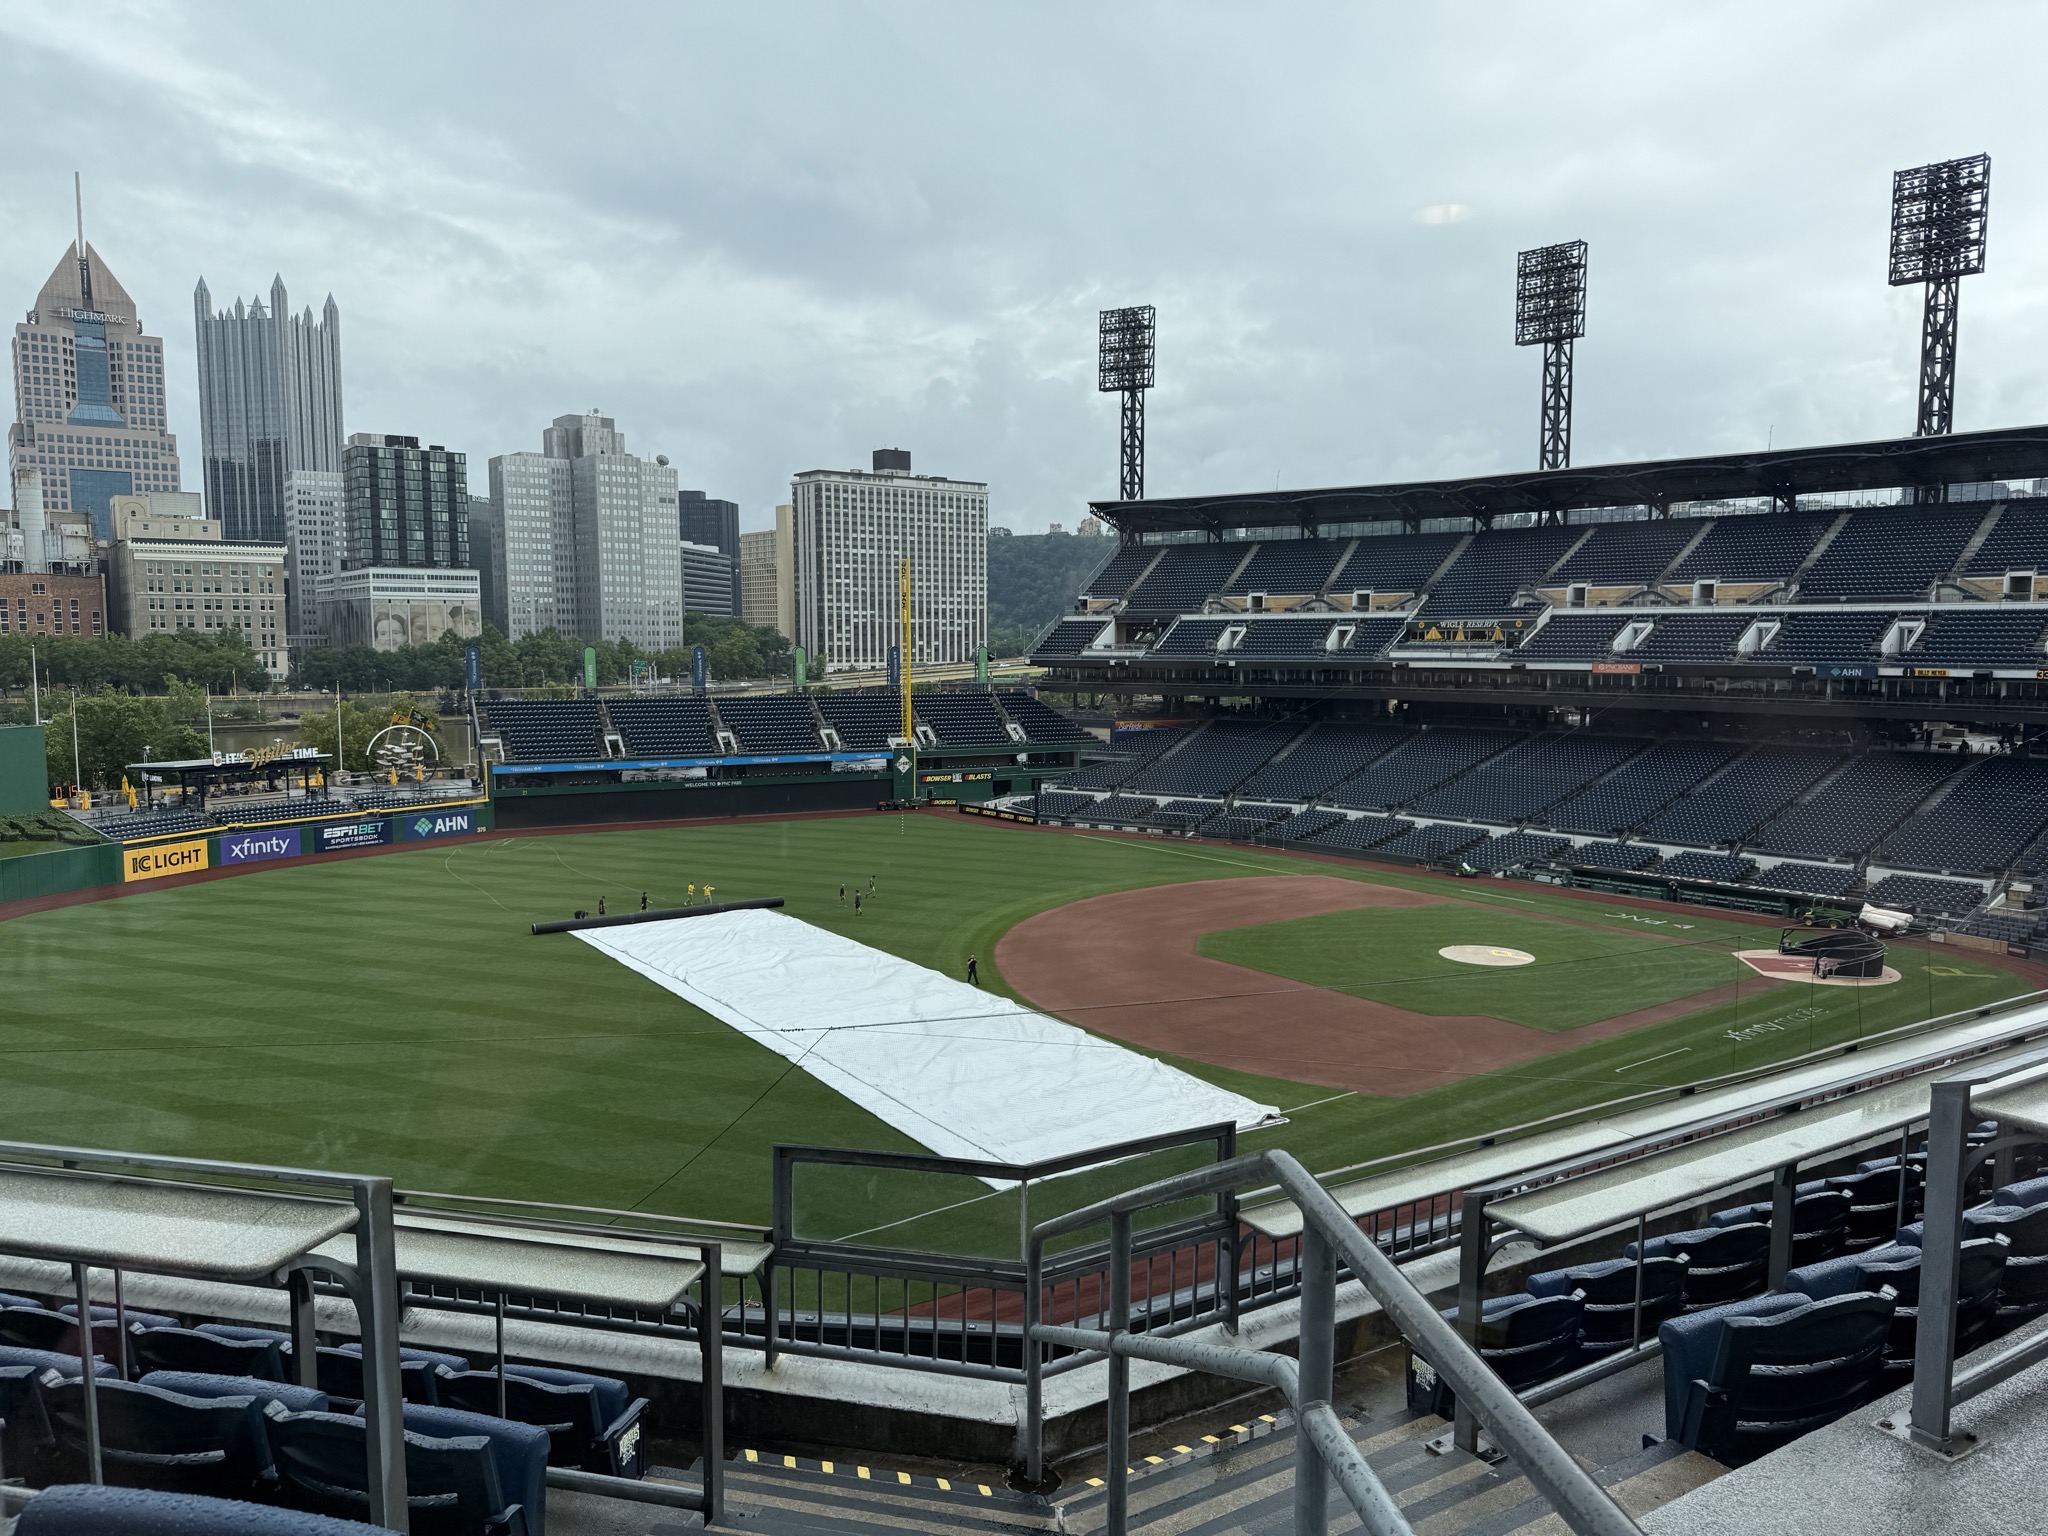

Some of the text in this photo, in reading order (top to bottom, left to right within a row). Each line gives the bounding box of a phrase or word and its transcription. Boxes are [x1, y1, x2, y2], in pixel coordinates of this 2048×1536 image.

[60, 308, 126, 324] HIGHMARK
[1466, 620, 1499, 628] RESERVE
[242, 742, 300, 770] Miller
[292, 748, 318, 760] TIME
[434, 816, 468, 833] AHN
[231, 836, 290, 858] xfinity
[330, 834, 378, 844] SPORTSBOOK
[132, 849, 201, 873] IC LIGHT
[1722, 1020, 1785, 1042] xfinity
